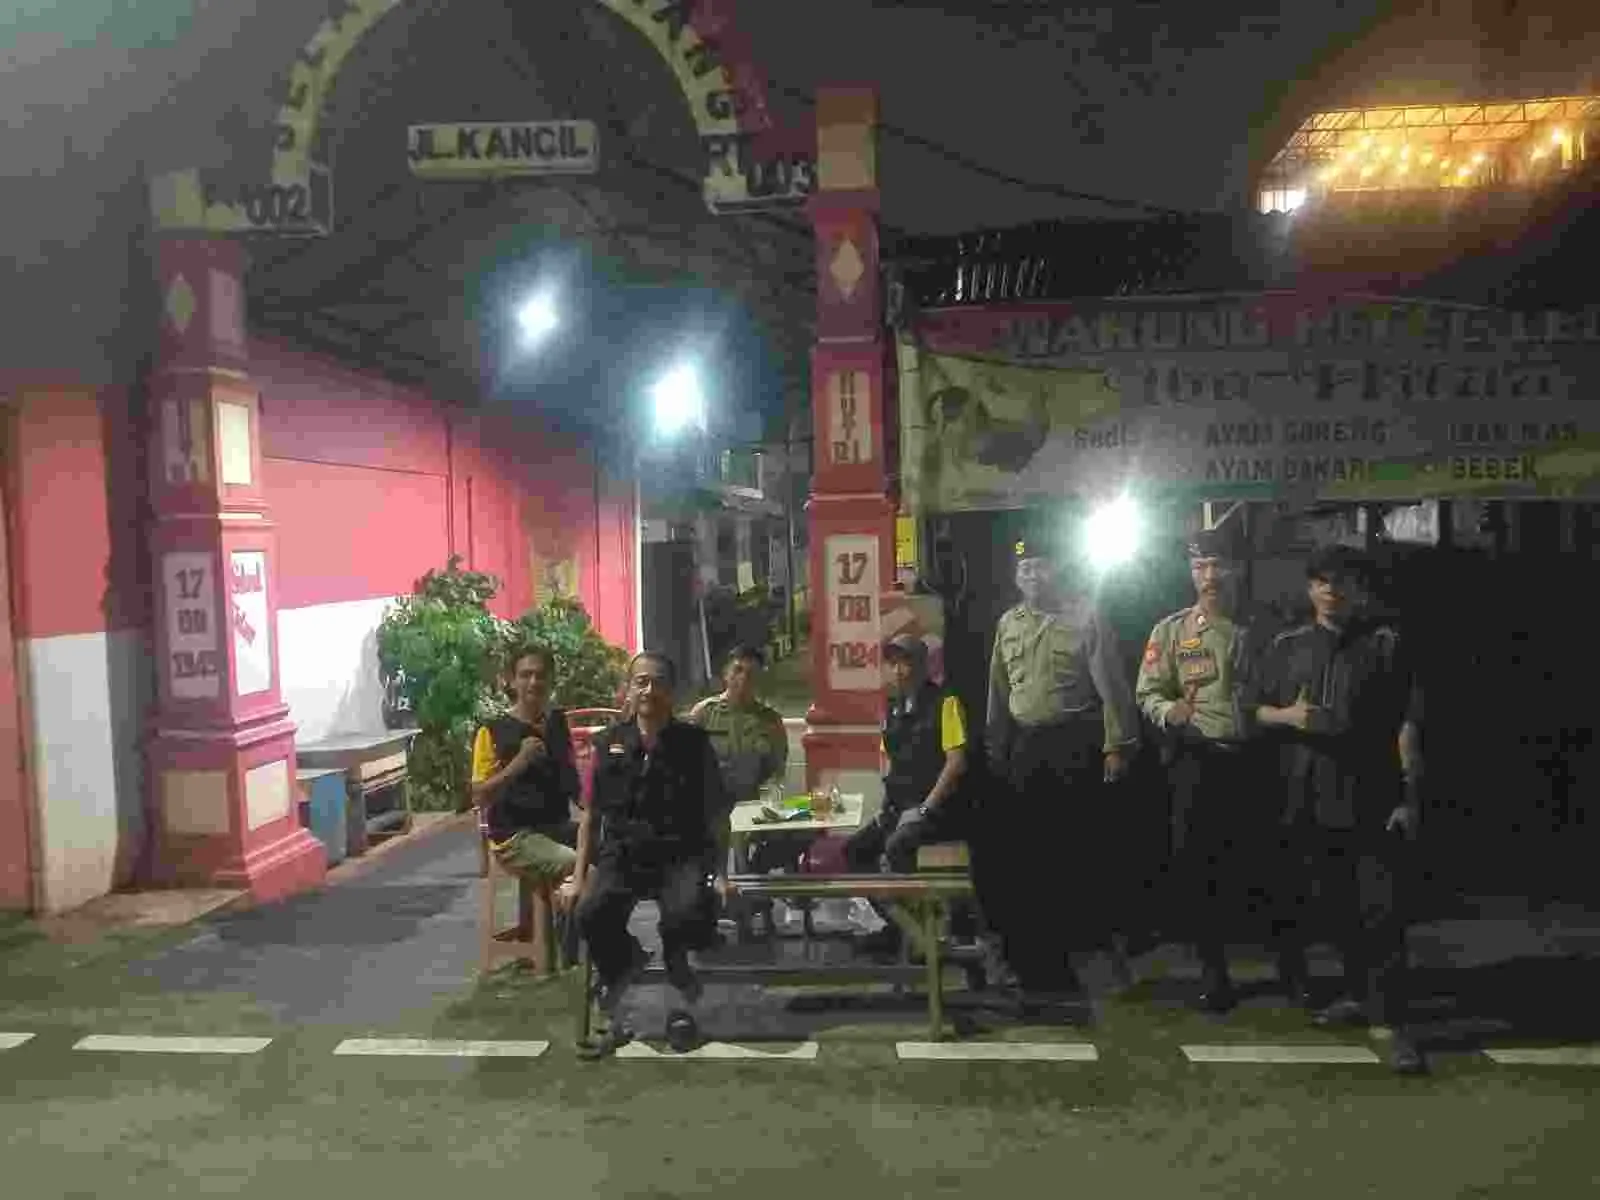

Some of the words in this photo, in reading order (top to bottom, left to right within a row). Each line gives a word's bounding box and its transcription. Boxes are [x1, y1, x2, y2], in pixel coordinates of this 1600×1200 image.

[458, 124, 590, 160] KANCIL
[1008, 306, 1272, 355] WARUNG
[1205, 422, 1273, 446] AYAM
[1284, 420, 1390, 446] GORENG
[1206, 457, 1273, 481] AYAM
[1452, 455, 1538, 481] BEBEK
[173, 566, 206, 599] 17
[834, 551, 871, 585] 17
